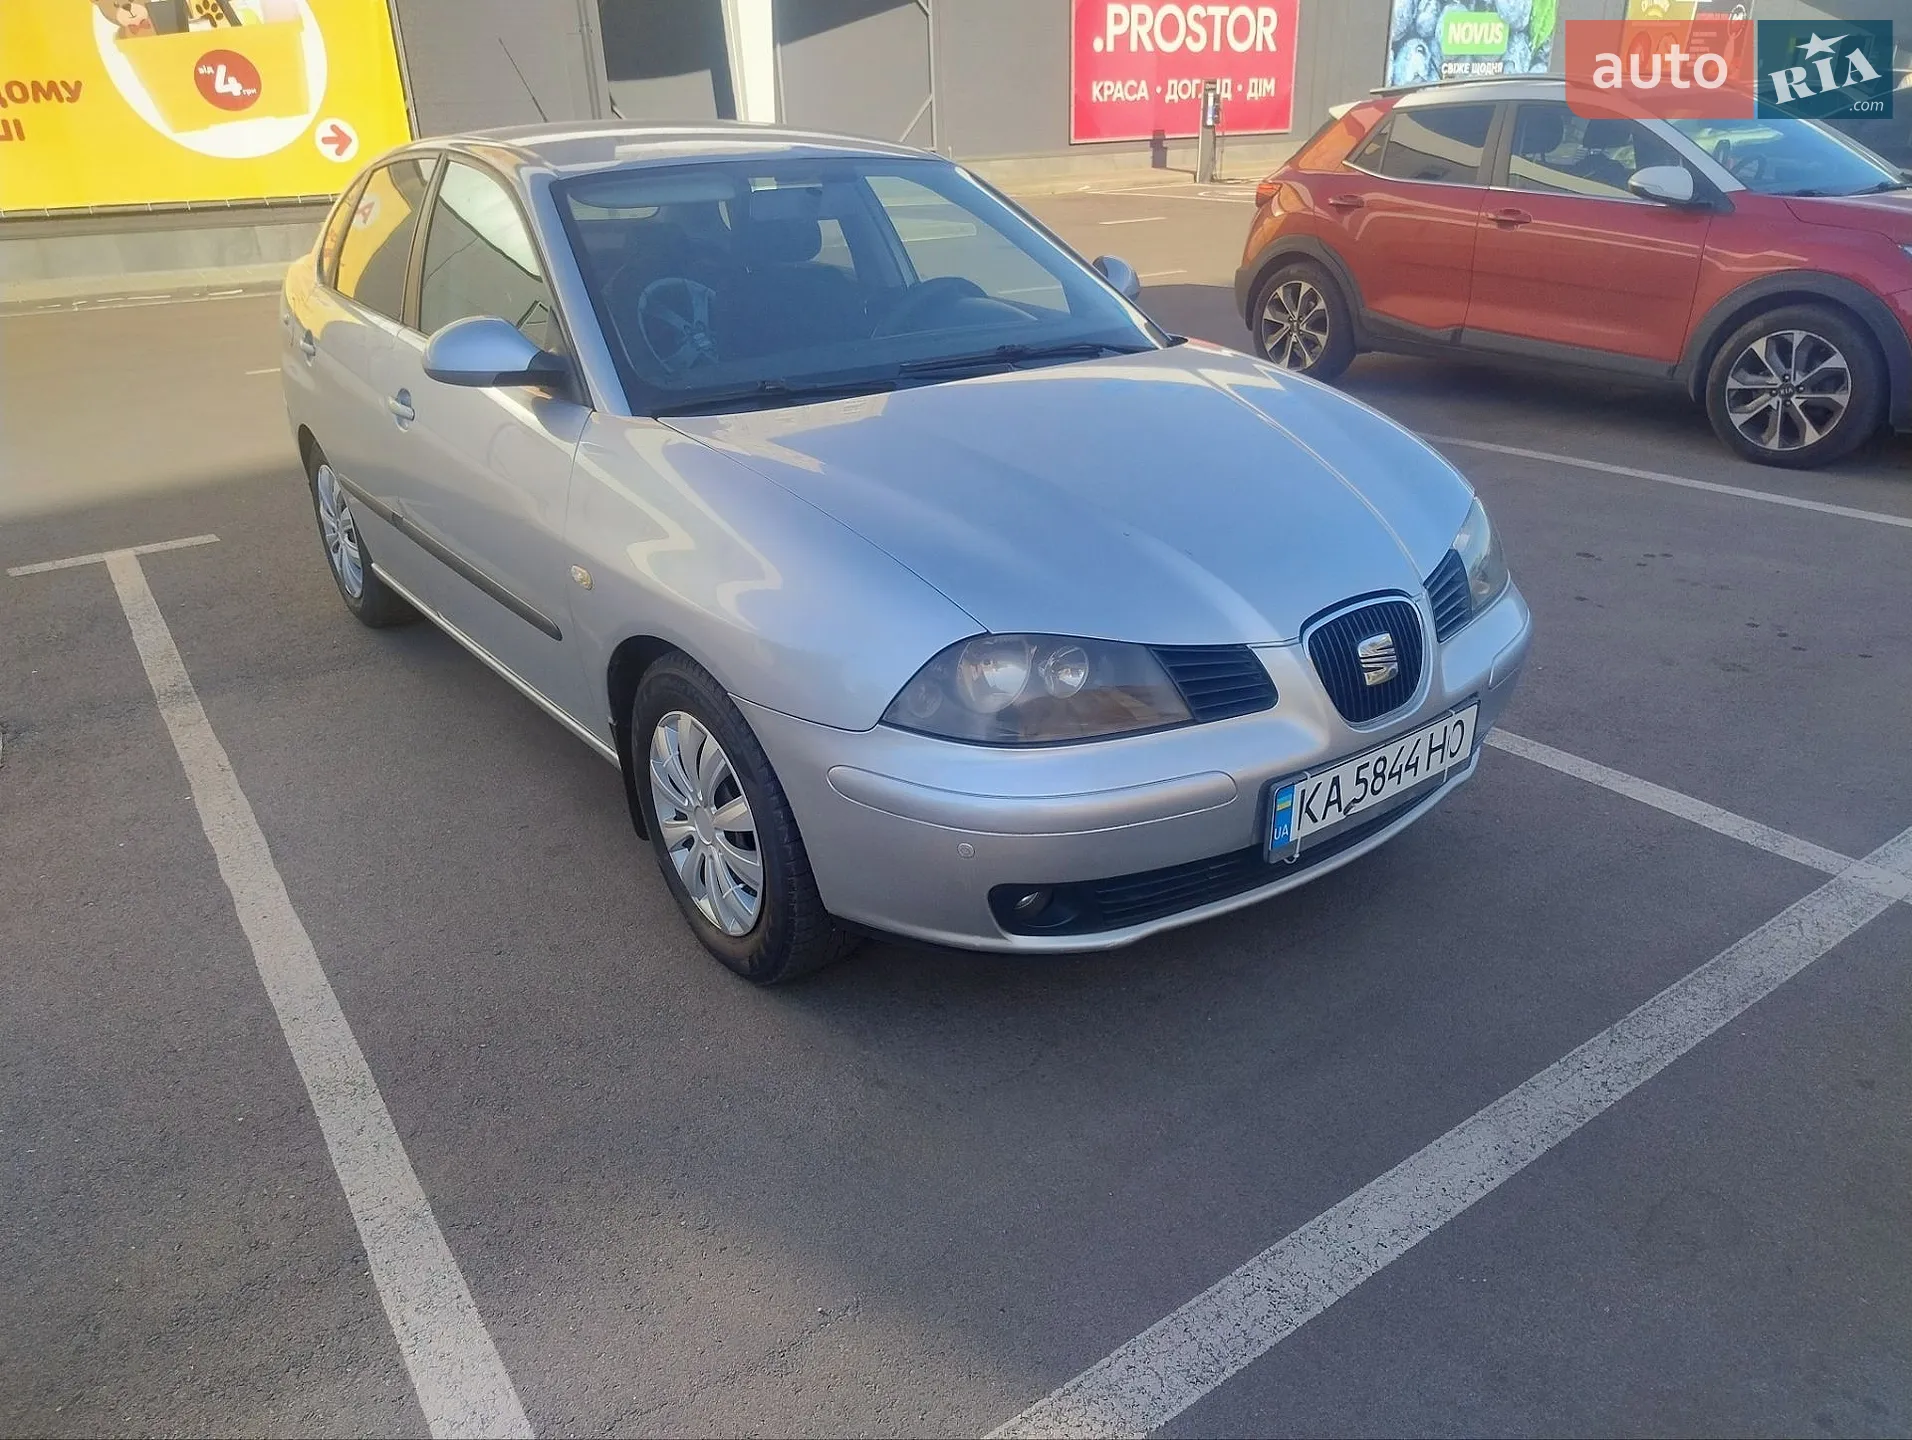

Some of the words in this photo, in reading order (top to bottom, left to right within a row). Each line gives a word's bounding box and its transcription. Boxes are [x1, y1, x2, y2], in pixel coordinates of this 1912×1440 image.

[1447, 21, 1505, 45] NOVUS
[214, 63, 243, 97] 4
[1441, 62, 1470, 75] СВІЖЕ
[1091, 79, 1150, 103] КРАСА
[1246, 77, 1276, 101] ДІМ
[1353, 737, 1422, 804] 5844
[1273, 826, 1290, 841] UA
